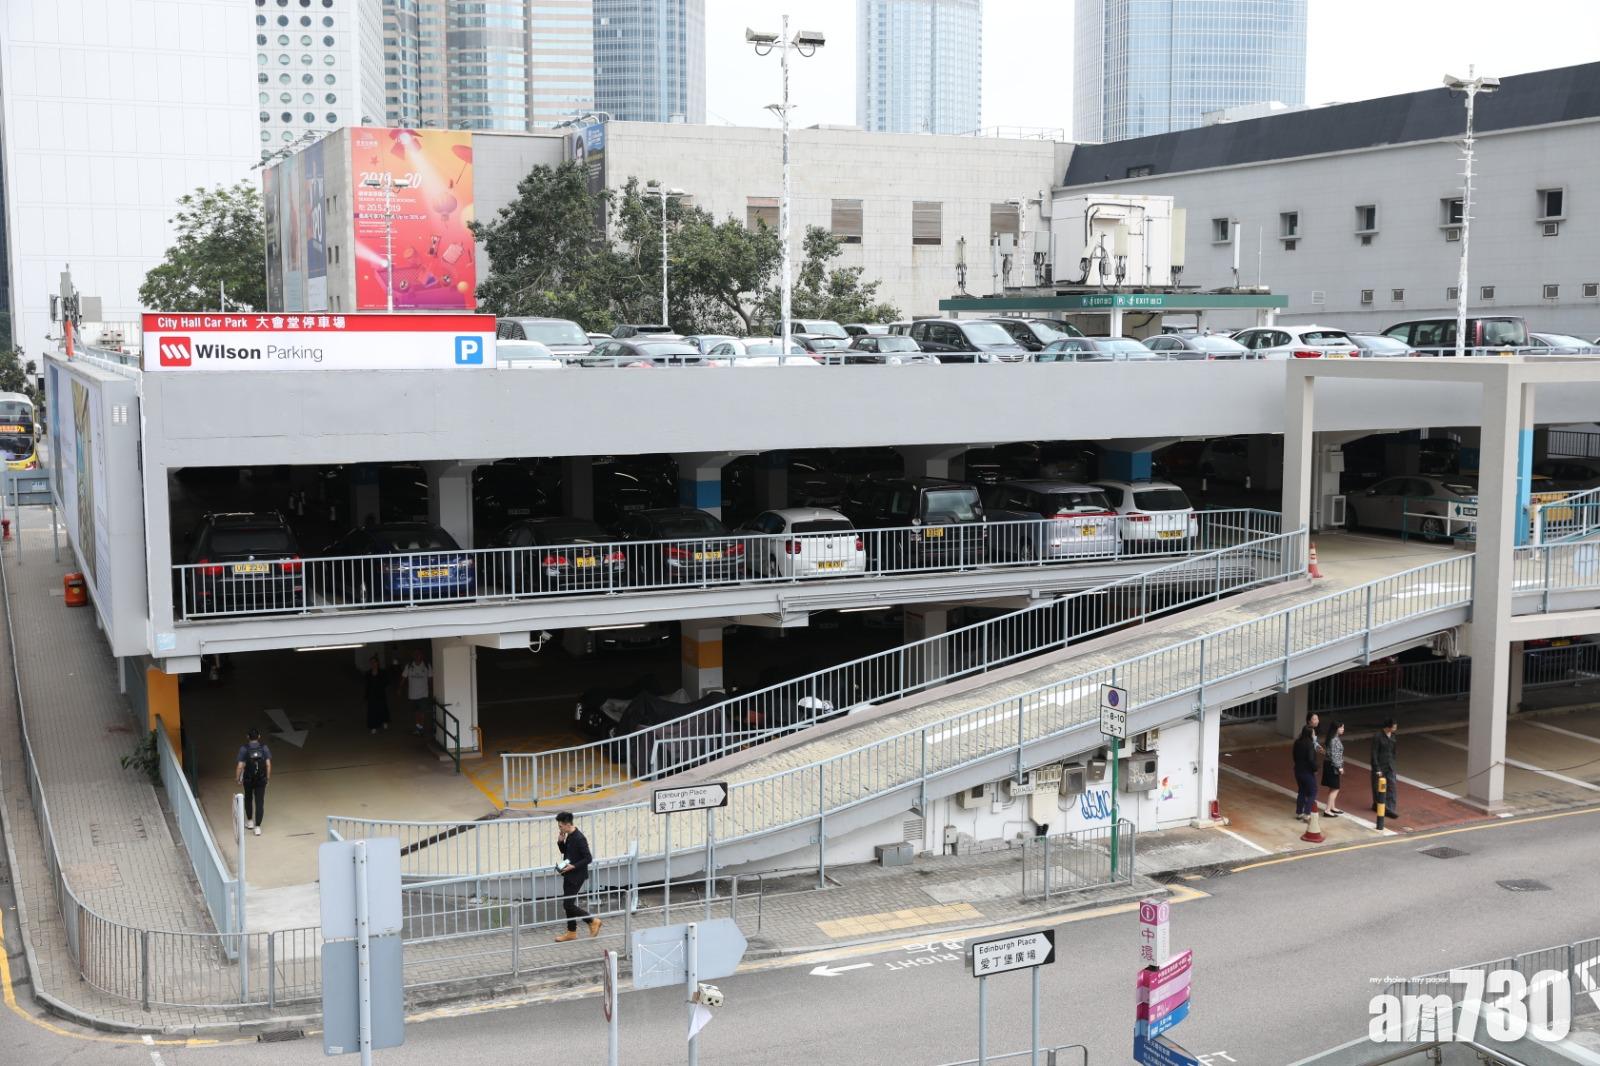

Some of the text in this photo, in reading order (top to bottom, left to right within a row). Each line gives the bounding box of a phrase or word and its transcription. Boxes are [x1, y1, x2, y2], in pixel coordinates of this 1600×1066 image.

[157, 315, 346, 330] City Hall Car Park 大會堂停車場
[195, 344, 324, 362] Wilson Parking
[461, 340, 479, 361] P
[657, 788, 708, 799] Edinburgh Place
[979, 941, 1015, 955] Edinburgh
[1017, 937, 1037, 947] Place
[1141, 927, 1155, 963] 中環
[980, 949, 1037, 970] 愛丁堡廣場
